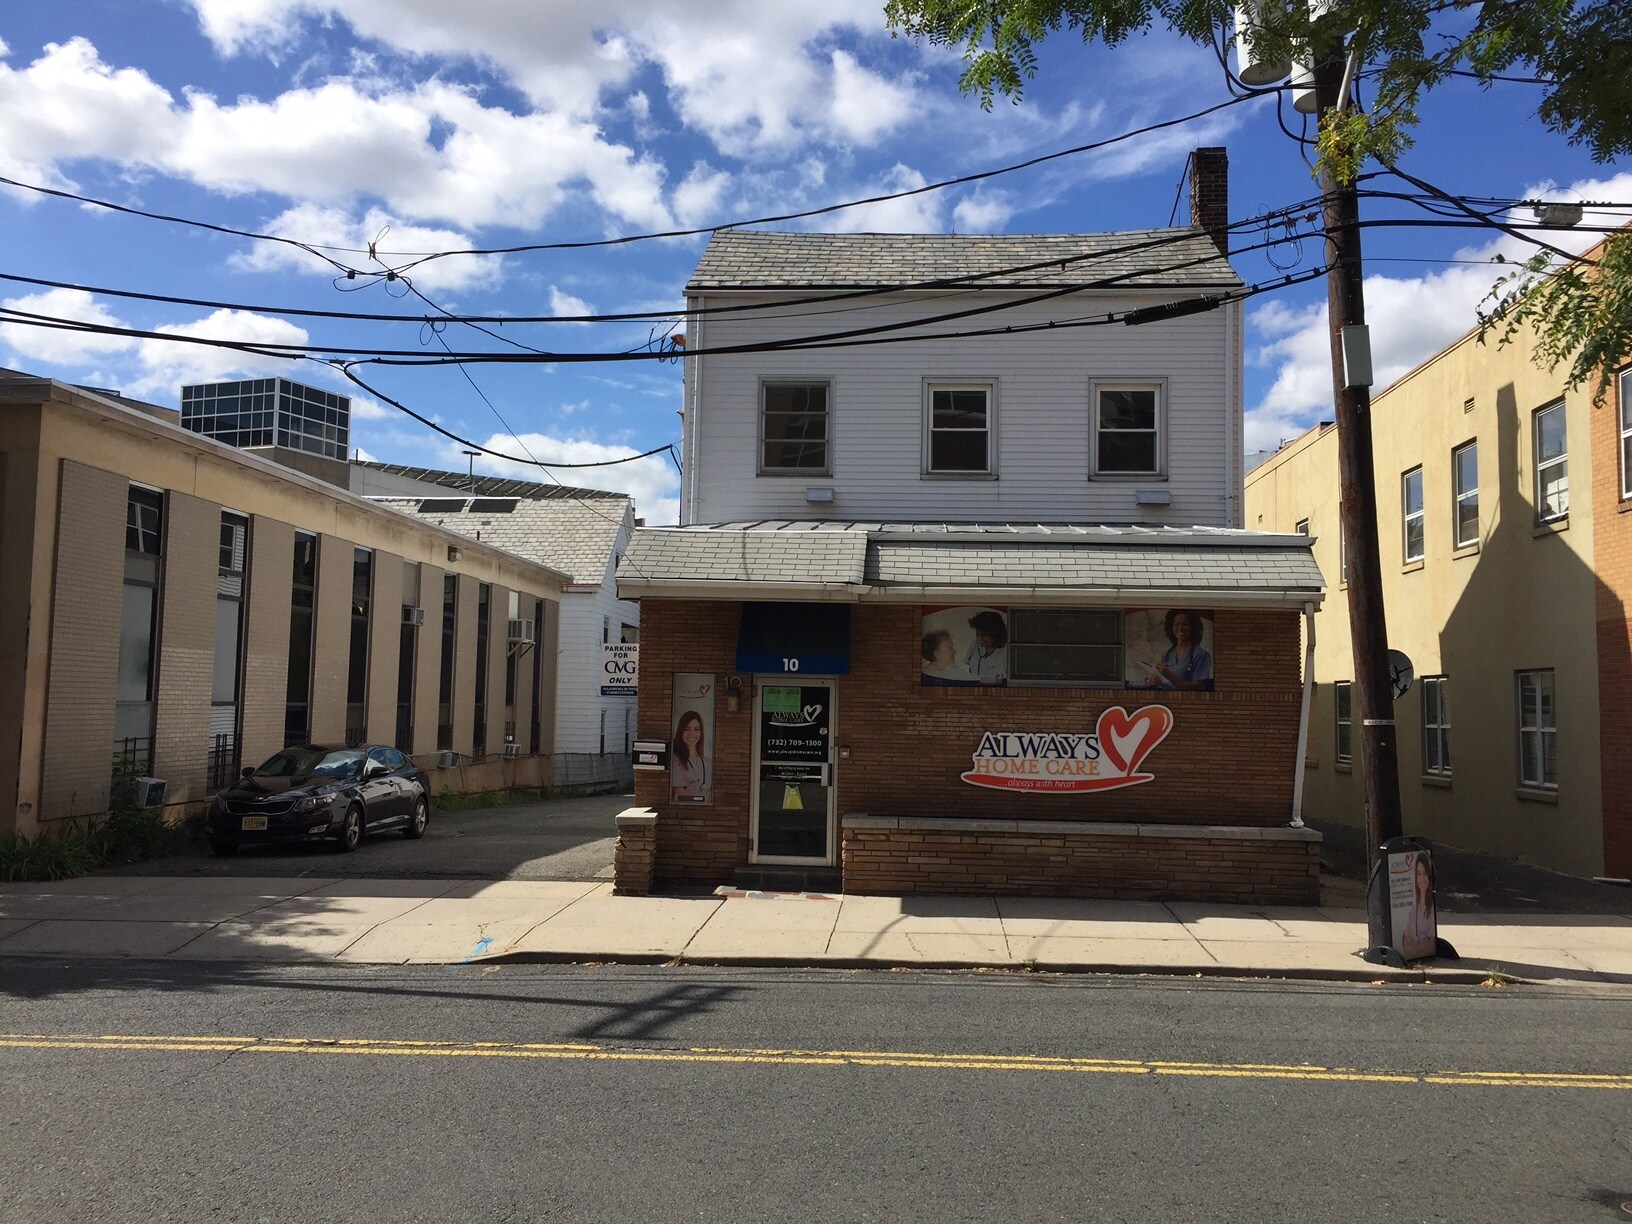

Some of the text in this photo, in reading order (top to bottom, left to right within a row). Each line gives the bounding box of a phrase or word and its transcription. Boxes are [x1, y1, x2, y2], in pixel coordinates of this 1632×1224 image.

[604, 660, 637, 674] CMG
[782, 658, 800, 672] 10
[723, 675, 742, 689] 10
[771, 711, 805, 719] ALWAYS
[767, 739, 822, 747] (732) 709-1300
[976, 733, 1100, 760] ALWAYS
[975, 759, 1100, 776] HOME CARE
[1036, 779, 1053, 788] with
[1054, 780, 1076, 789] heart
